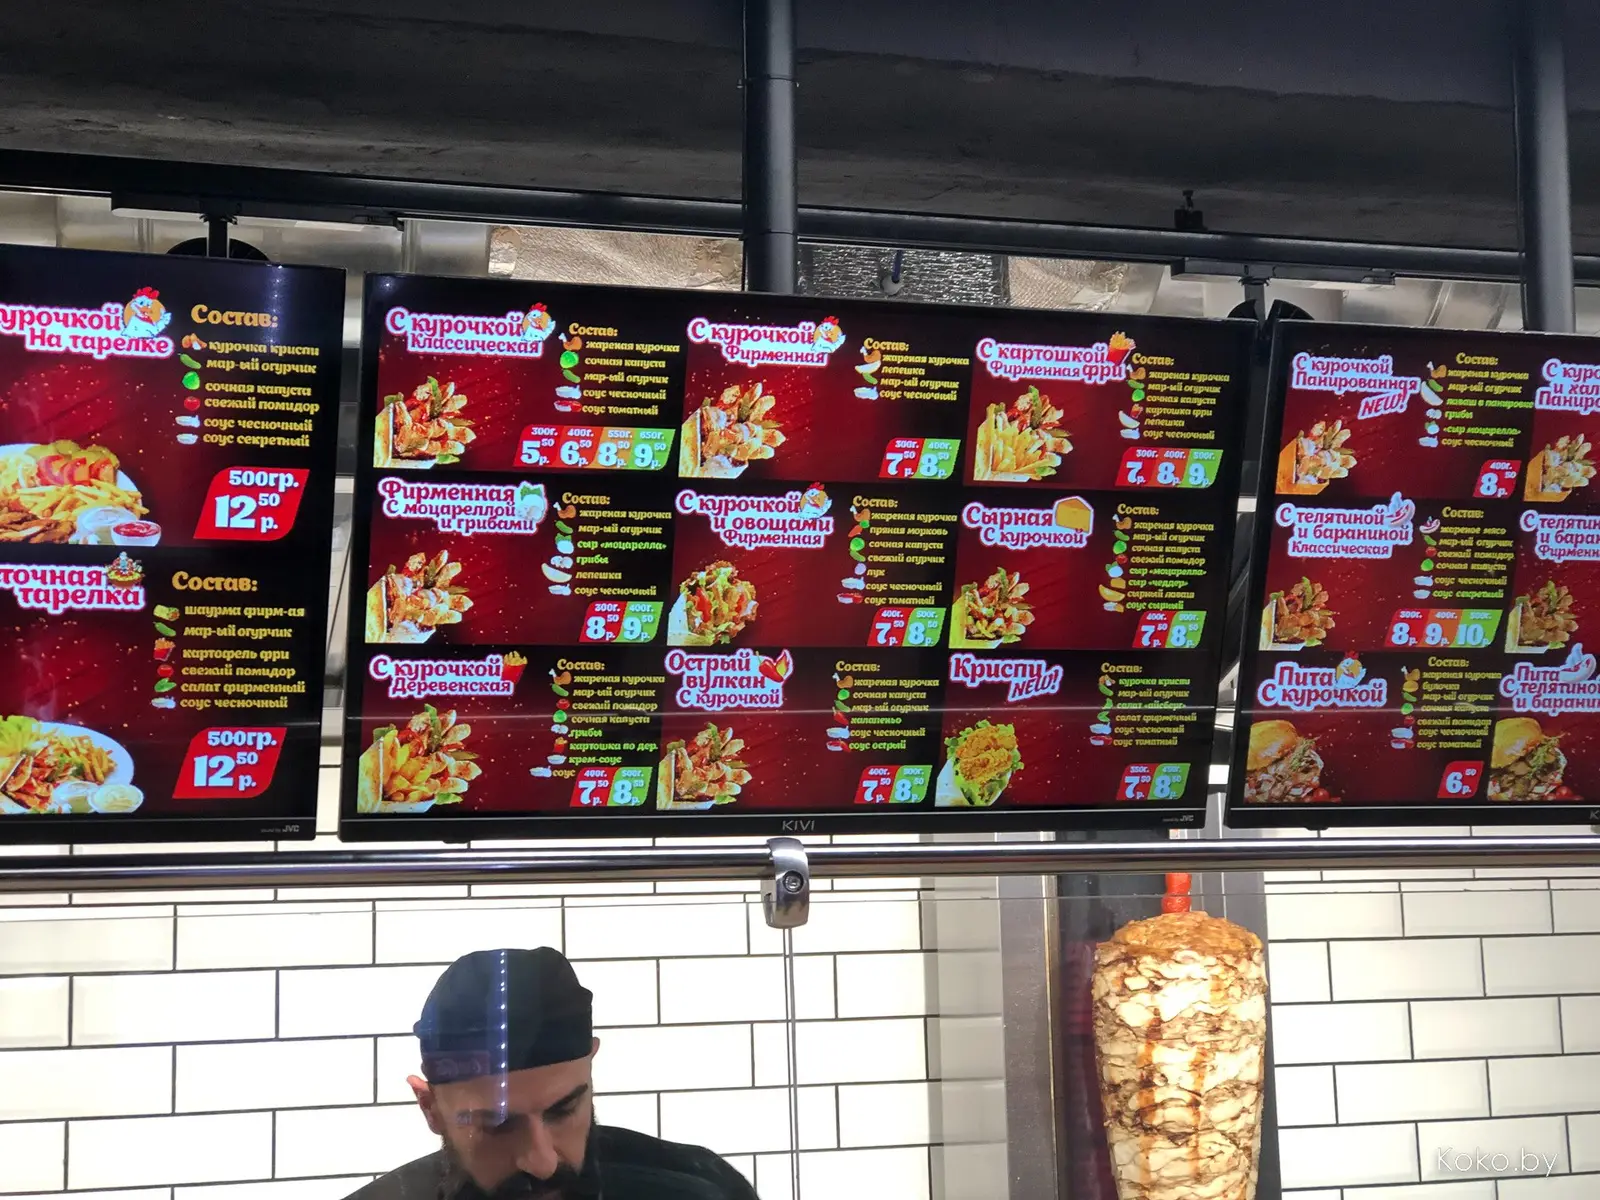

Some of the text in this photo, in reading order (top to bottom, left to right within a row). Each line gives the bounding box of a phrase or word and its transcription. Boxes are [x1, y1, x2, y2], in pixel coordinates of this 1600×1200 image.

[191, 305, 278, 328] Состав:
[390, 311, 522, 339] С курочкой
[569, 324, 617, 336] Состав:
[692, 322, 813, 346] С курочкой
[29, 329, 169, 356] На тарелке
[209, 341, 320, 356] курочка криспи
[410, 334, 538, 354] Классическая
[586, 340, 680, 354] жареная курочка
[864, 338, 909, 351] Состав:
[726, 347, 825, 364] Фирменная
[883, 354, 969, 366] жареная курочка
[980, 342, 1105, 364] С картошкой
[1132, 354, 1174, 365] Состав:
[1456, 353, 1498, 365] Состав:
[207, 358, 317, 375] мар-ый огурчик
[585, 358, 666, 369] сочная капуста
[990, 361, 1123, 379] Фирменная фри
[1296, 358, 1391, 376] С курочкой
[584, 371, 668, 385] мар-ый огурчик
[881, 377, 959, 389] мар-ый огурчик
[1296, 373, 1417, 392] Панированная
[205, 382, 311, 398] сочная капуста
[583, 389, 666, 400] соус чесночный
[880, 390, 957, 401] соус чесночный
[205, 397, 320, 414] свежий помидор
[582, 405, 658, 415] соус томатный
[1362, 391, 1406, 416] NEW!
[204, 418, 312, 431] соус чесночный
[203, 434, 309, 447] соус секретный
[229, 471, 299, 491] 500гр.
[382, 482, 514, 504] Фирменная
[562, 493, 610, 505] Состав:
[679, 493, 799, 516] С курочкой
[853, 496, 898, 508] Состав:
[215, 494, 280, 533] 12 50 р.
[387, 501, 515, 520] С моцареллой
[580, 509, 672, 520] жареная курочка
[966, 506, 1053, 527] Сырная
[1118, 504, 1159, 515] Состав:
[1442, 507, 1484, 519] Состав:
[1280, 509, 1384, 525] С телятиной
[1524, 514, 1534, 528] С
[579, 523, 662, 535] мар-ый огурчик
[713, 518, 830, 532] и овощами
[724, 530, 821, 546] Фирменная
[984, 528, 1083, 547] С курочкой
[1299, 525, 1408, 543] и бараниной
[578, 540, 598, 550] сыр
[1292, 542, 1389, 556] Классическая
[172, 571, 257, 592] Состав:
[19, 586, 139, 609] тарелка
[574, 586, 656, 596] соус чесночный
[185, 606, 304, 619] шаурма фирм-ая
[184, 625, 292, 639] мар-ый огурчик
[183, 648, 289, 662] картофель фри
[557, 659, 605, 670] Состав:
[669, 652, 750, 681] Острый
[836, 661, 880, 672] Состав:
[1101, 663, 1142, 674] Состав:
[1428, 657, 1469, 668] Состав:
[182, 664, 296, 679] свежий помидор
[373, 659, 501, 681] С курочкой
[954, 658, 1042, 683] Криспи
[1279, 668, 1333, 685] Пита
[1518, 666, 1559, 681] Пита
[181, 681, 305, 695] салат фирменный
[392, 680, 510, 694] Деревенская
[686, 675, 765, 692] вулкан
[1013, 671, 1058, 697] NEW!
[181, 696, 288, 709] соус чесночный
[680, 691, 780, 708] С курочкой
[1262, 685, 1383, 706] С курочкой
[208, 731, 277, 748] 500гр.
[849, 741, 906, 750] соус острый
[569, 756, 622, 765] крем-соус
[194, 753, 258, 791] 12 50 р.
[553, 769, 575, 779] соус
[782, 820, 815, 831] KIVI
